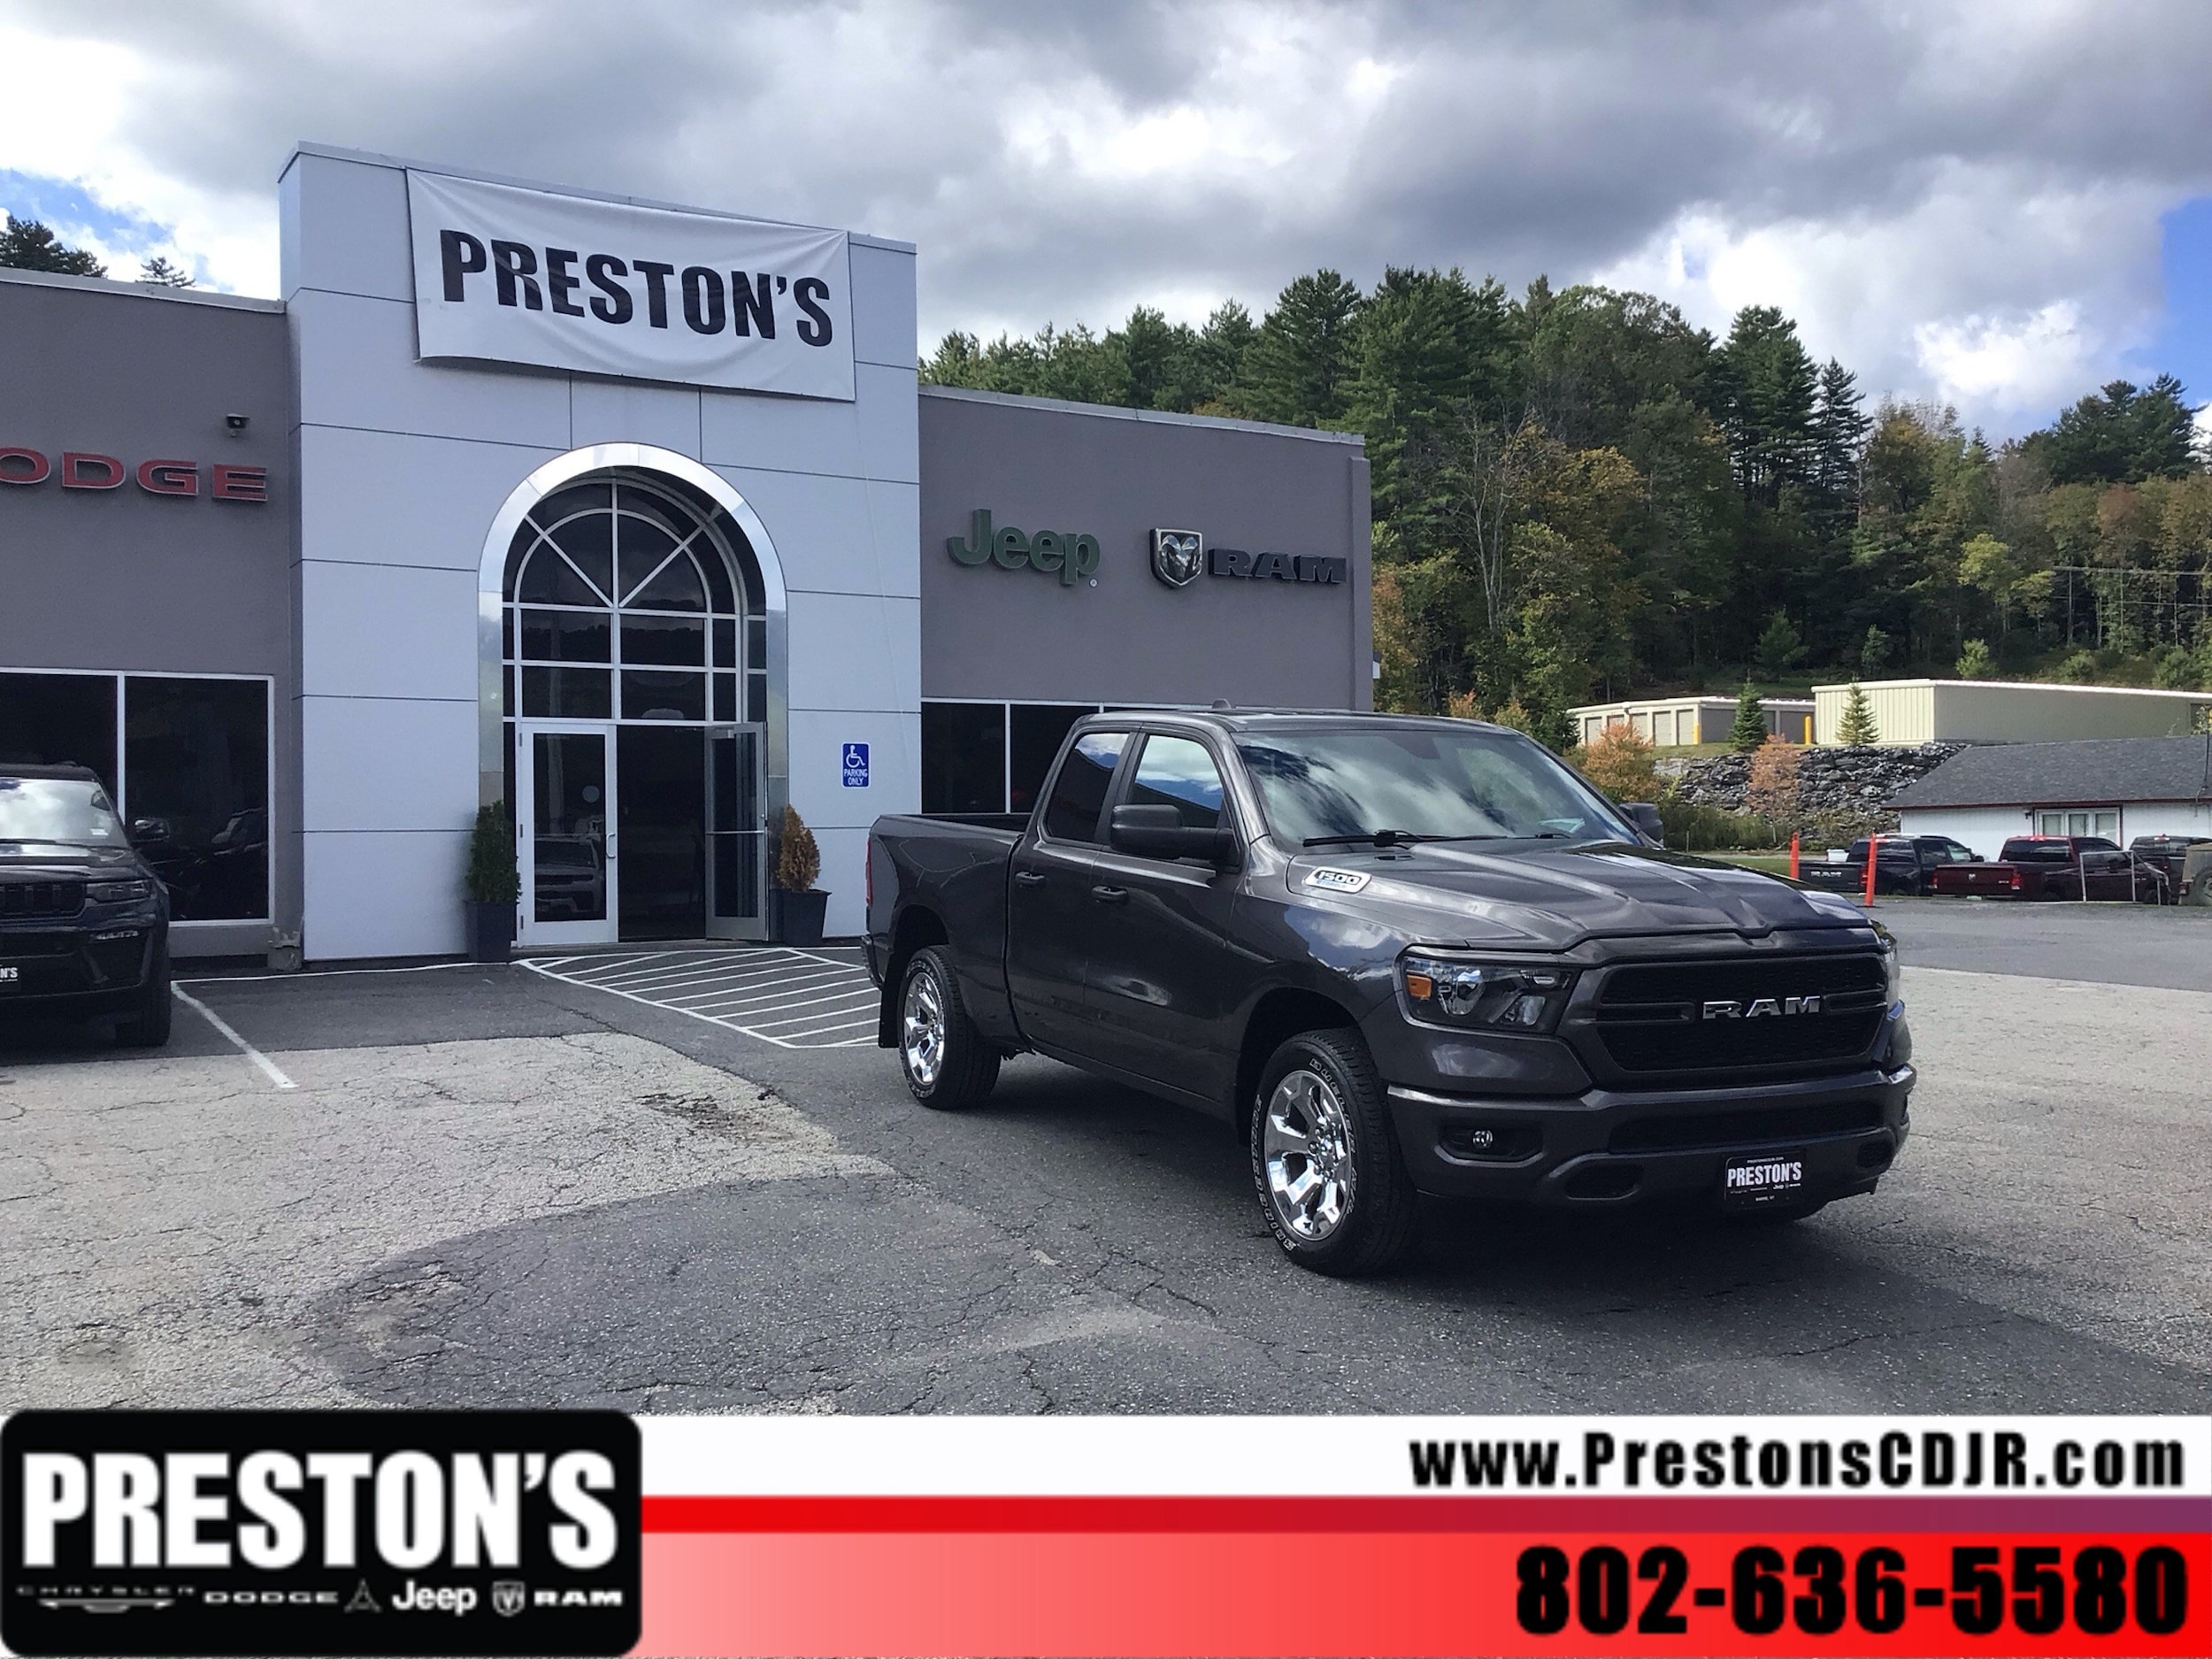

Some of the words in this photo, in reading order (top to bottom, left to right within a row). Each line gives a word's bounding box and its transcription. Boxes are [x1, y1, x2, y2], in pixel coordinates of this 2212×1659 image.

[439, 229, 833, 347] PRESTON'S
[947, 509, 1100, 586] Jeep
[1208, 548, 1348, 584] RAM
[843, 768, 868, 777] PARKING
[847, 776, 864, 786] ONLY
[1318, 871, 1362, 885] 1500
[1702, 995, 1821, 1019] RAM
[1727, 1161, 1802, 1187] PRESTON'S
